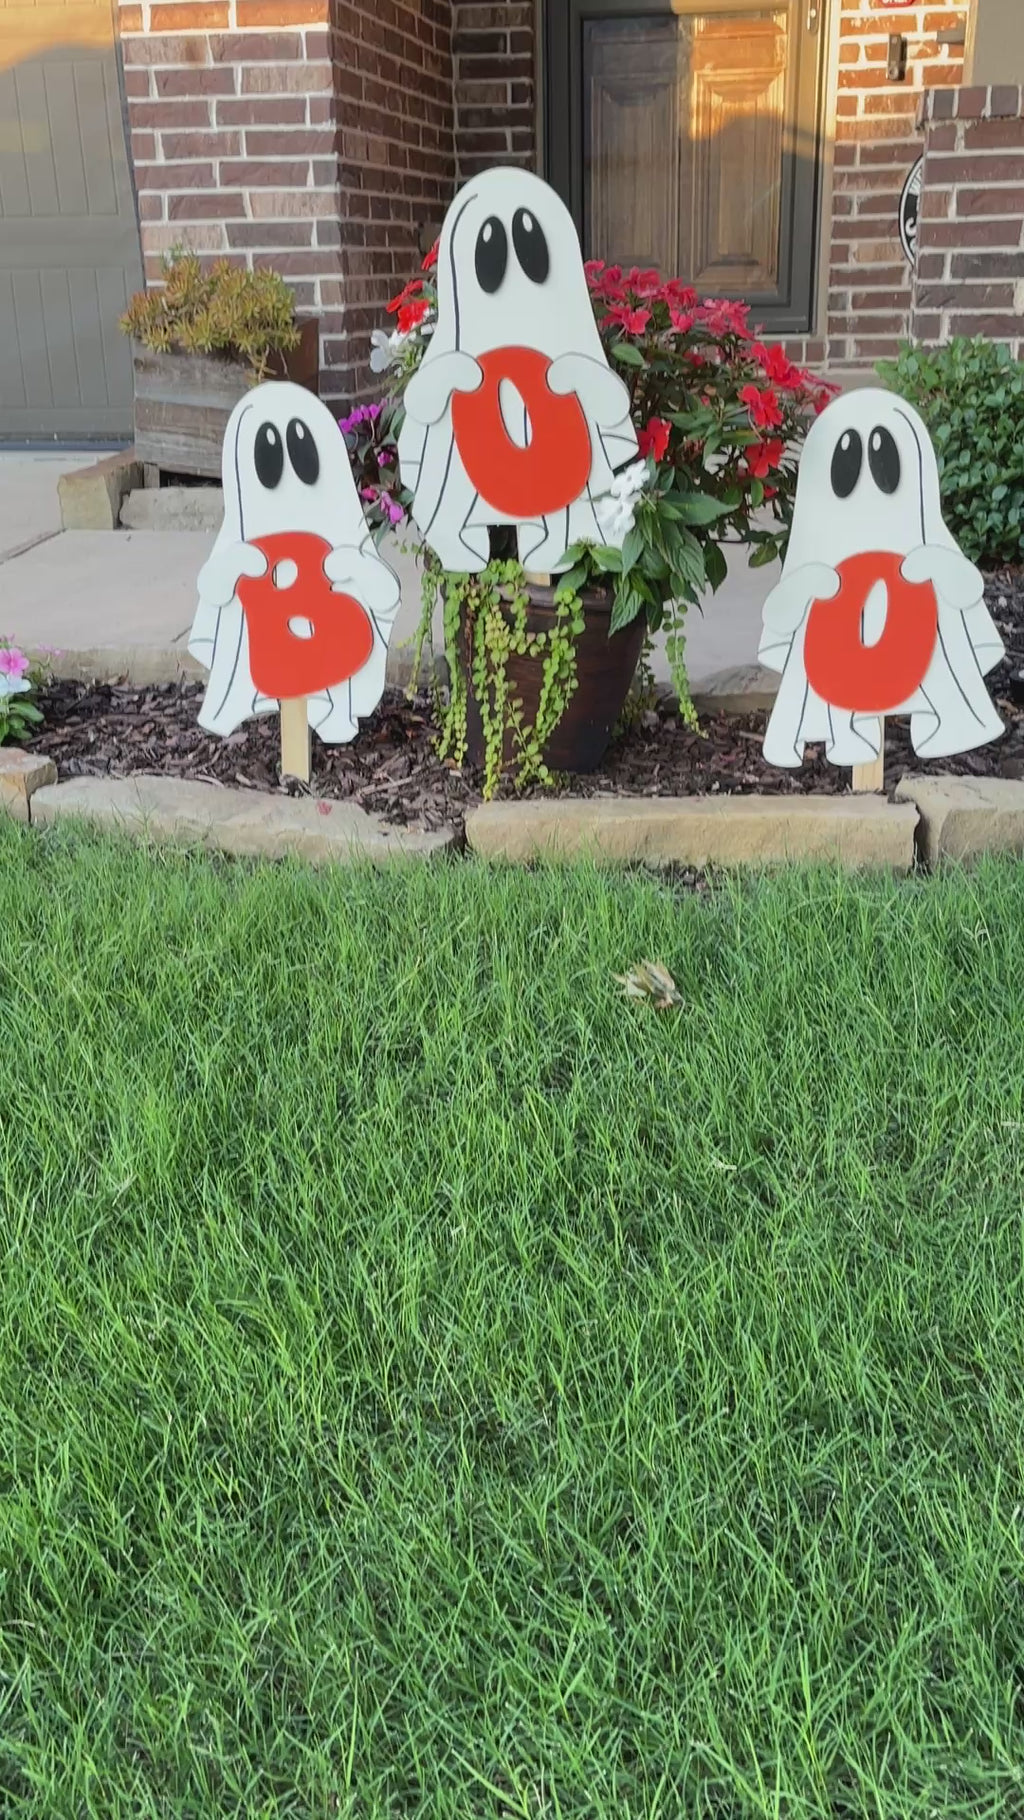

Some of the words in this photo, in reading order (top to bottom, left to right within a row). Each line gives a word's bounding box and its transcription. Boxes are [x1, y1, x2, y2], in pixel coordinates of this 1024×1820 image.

[451, 346, 592, 518] O
[237, 531, 374, 698] B
[804, 551, 937, 712] O
